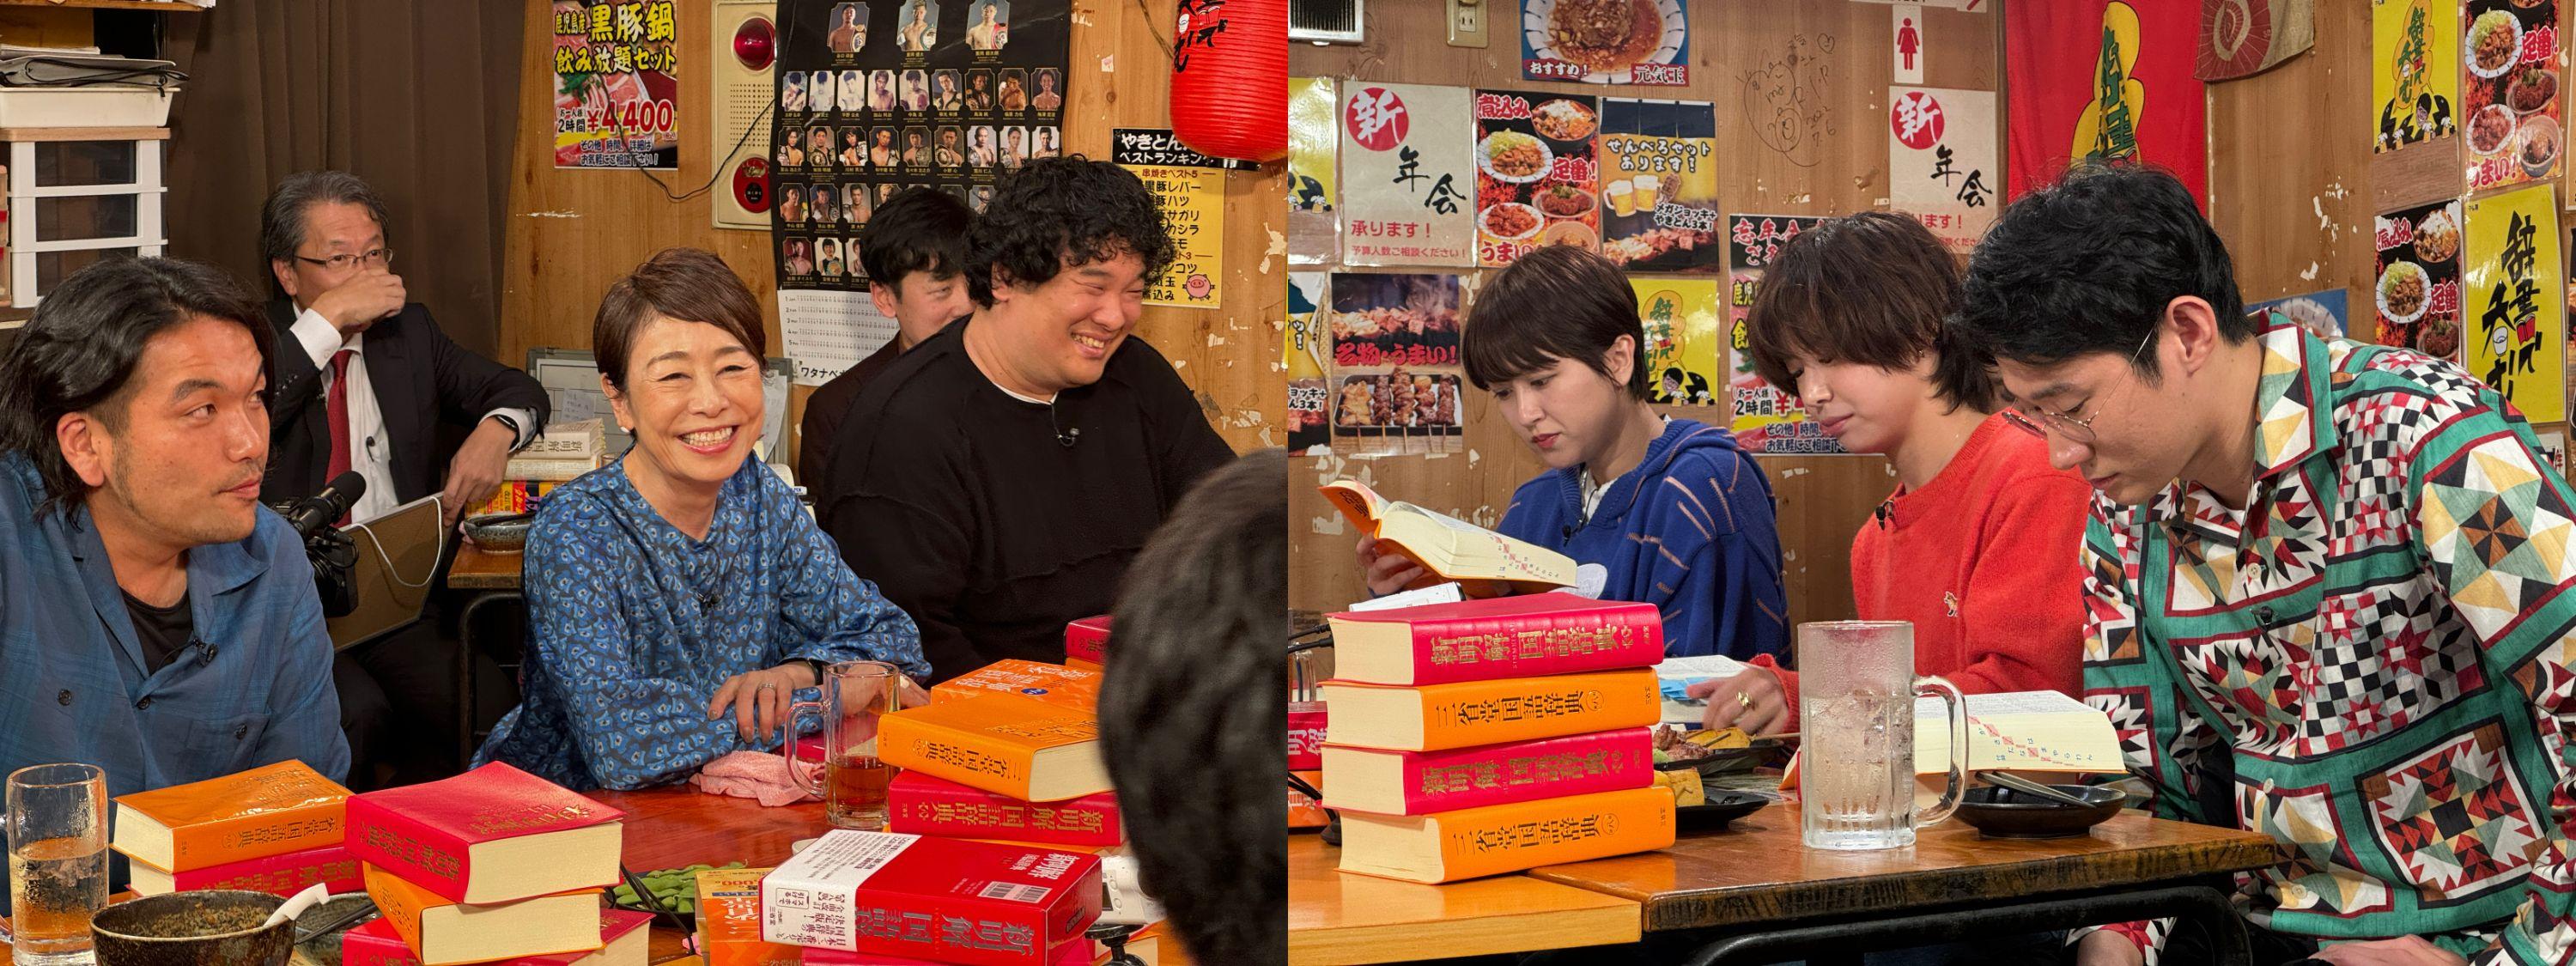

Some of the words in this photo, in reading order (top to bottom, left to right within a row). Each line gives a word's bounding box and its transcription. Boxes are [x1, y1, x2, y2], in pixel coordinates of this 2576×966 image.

[554, 12, 586, 34] 鹿児島産
[588, 1, 677, 43] 黒豚鍋
[554, 46, 676, 74] 飲み放題セット
[1634, 66, 1686, 84] 元気玉
[559, 119, 585, 133] 2時間
[587, 100, 674, 133] ¥4400
[1477, 94, 1531, 120] 煮込み
[581, 140, 601, 151] その他
[1121, 133, 1188, 151] やきとん
[1607, 138, 1711, 157] せんべろセット
[1142, 169, 1197, 178] 串焼きベスト5
[1154, 195, 1189, 207] 豚ハツ
[1480, 240, 1545, 263] うまい
[1165, 263, 1198, 274] ンコツ
[1732, 279, 1760, 307] 鹿児
[2431, 280, 2460, 315] 定番
[2501, 210, 2543, 377] 辞書で
[1288, 386, 1327, 399] ョッキ+
[1735, 400, 1773, 416] 2時間
[1766, 422, 1793, 437] その他
[1766, 437, 1847, 453] お気軽にご相談下
[1431, 623, 1619, 666] 新明解国語辞典
[1436, 690, 1584, 729] 三省堂国語辞典
[926, 741, 1022, 781] 三省堂国語辞典
[1422, 750, 1610, 796] 新明解国語辞典
[933, 802, 1104, 834] 新明解国語辞典
[1453, 814, 1600, 857] 三省堂国語辞典
